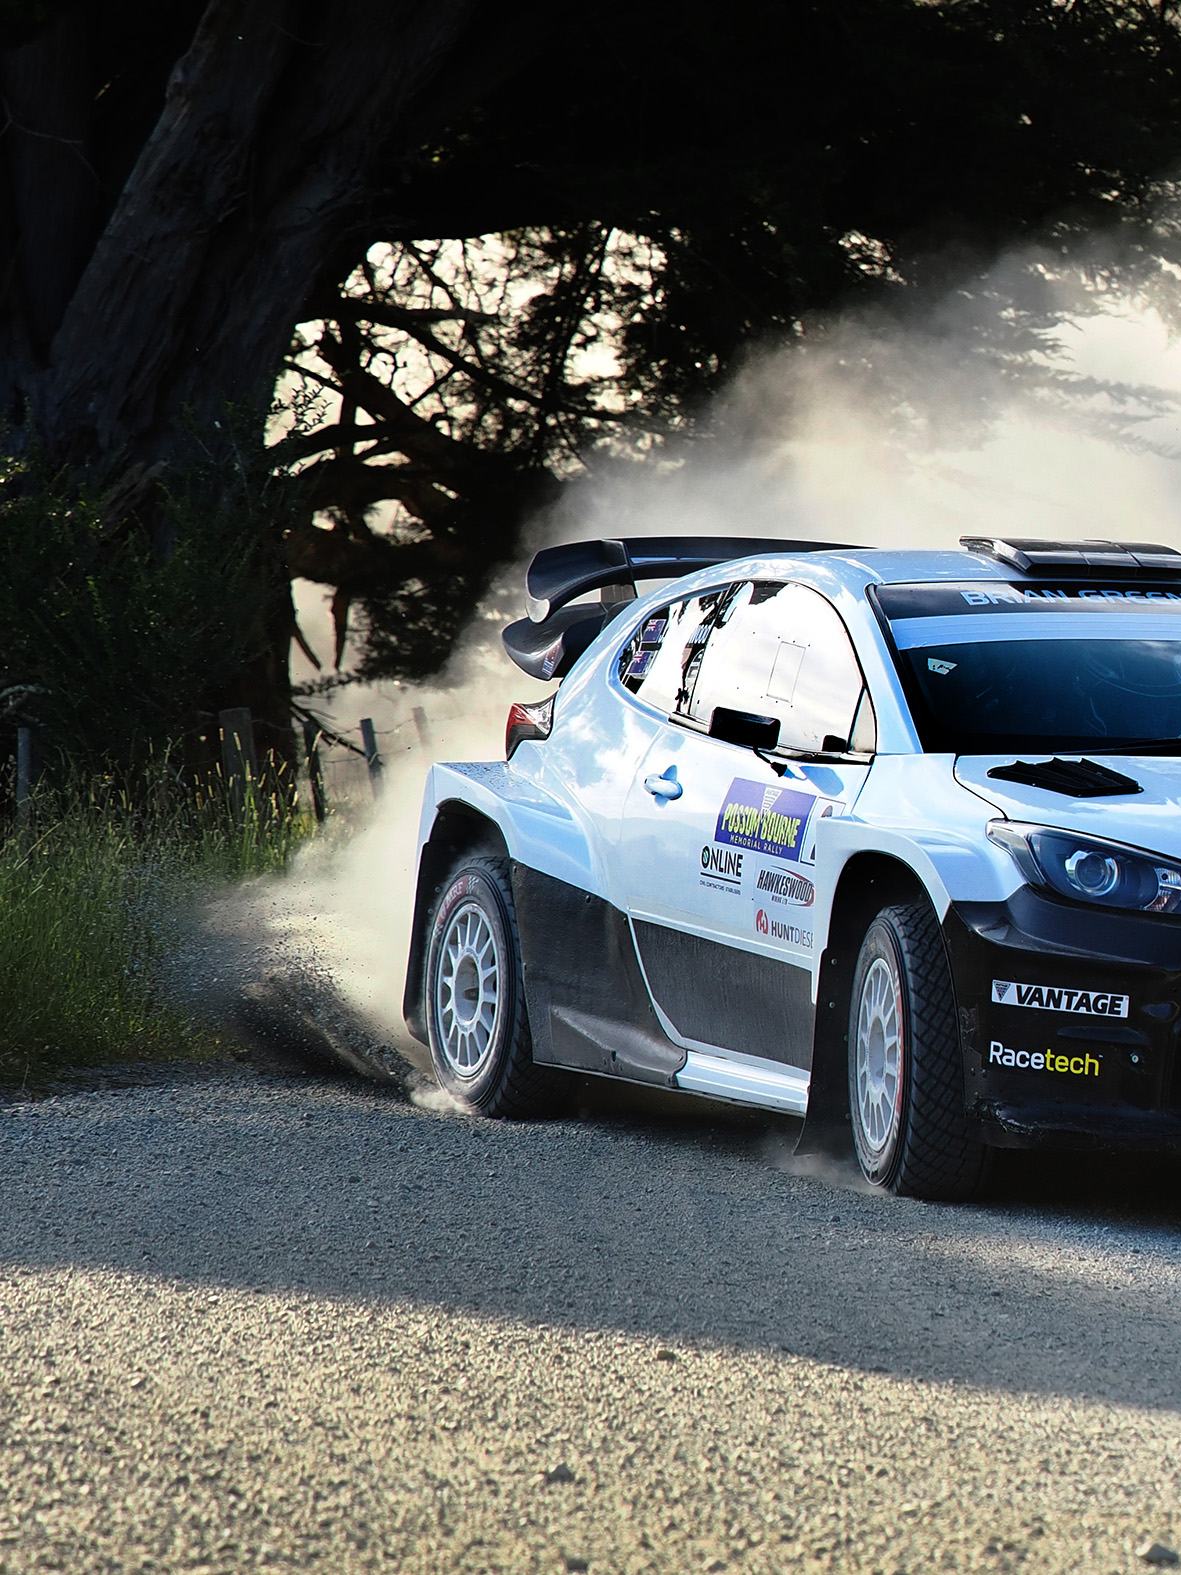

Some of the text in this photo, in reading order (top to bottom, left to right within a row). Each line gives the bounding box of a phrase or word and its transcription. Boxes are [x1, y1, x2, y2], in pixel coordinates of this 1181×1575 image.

[961, 590, 1071, 605] BRIAN
[721, 803, 801, 848] POSSUM BOURNE
[730, 834, 783, 854] MEMORIAL RALLY
[701, 846, 743, 877] ONLINE
[757, 870, 813, 902] HAWKESWOOD
[1016, 985, 1123, 1015] VANTAGE
[989, 1041, 1099, 1076] Racetech
